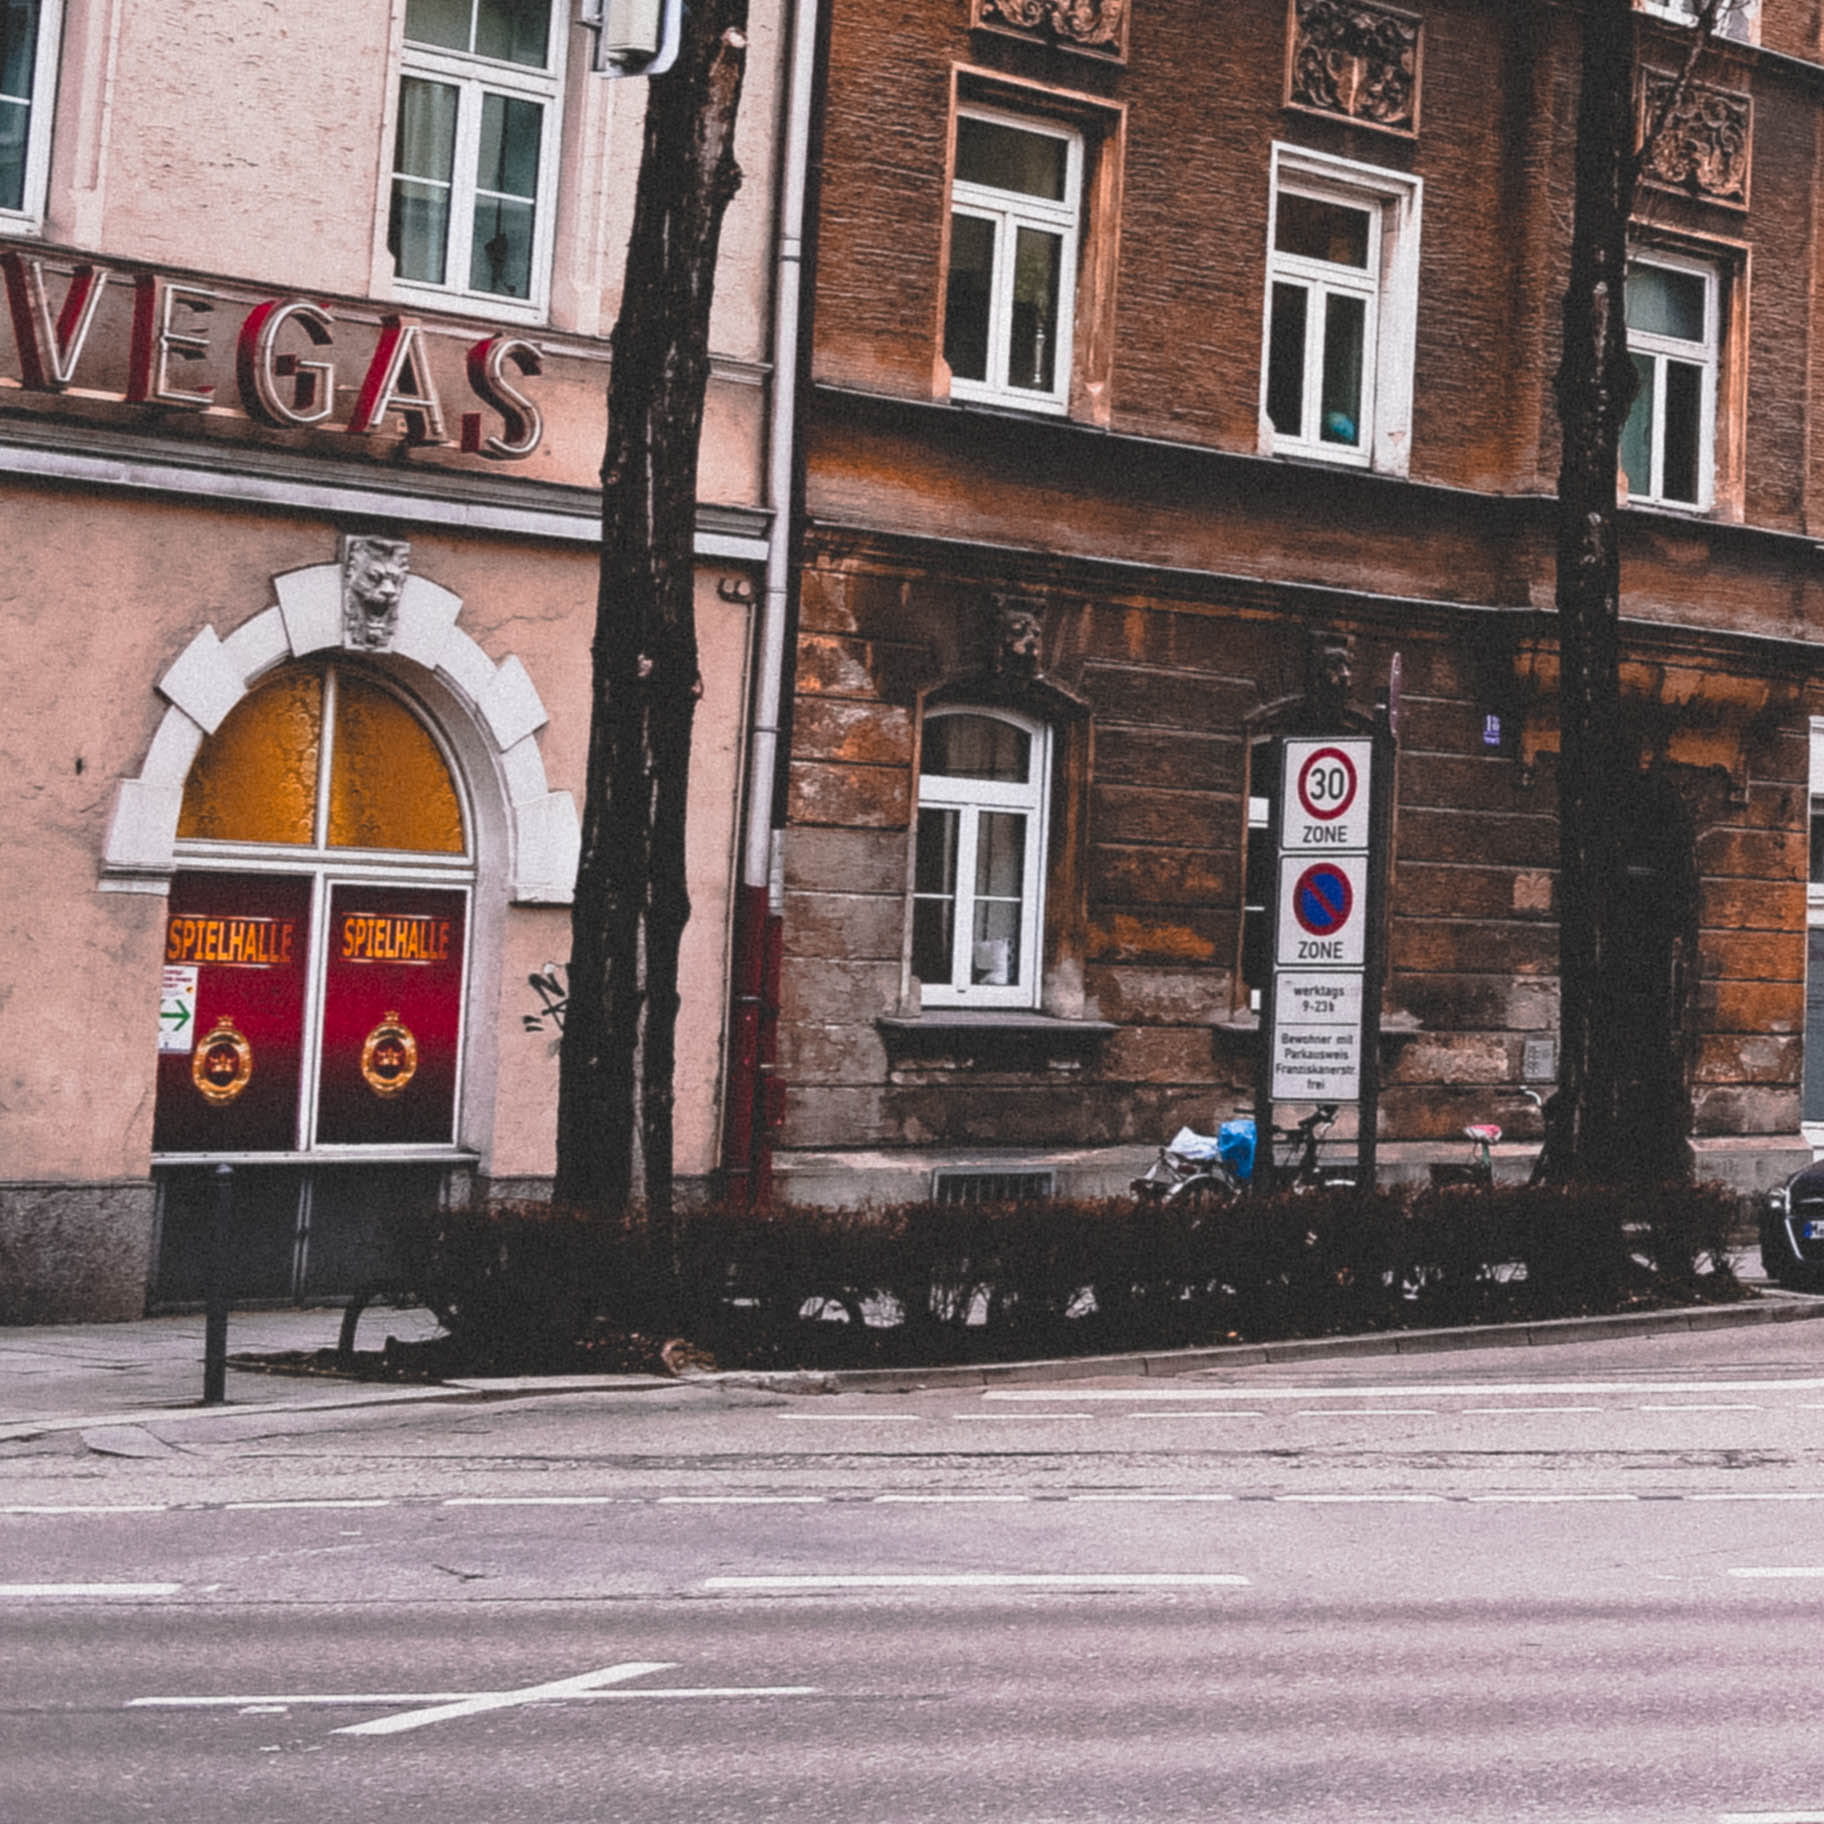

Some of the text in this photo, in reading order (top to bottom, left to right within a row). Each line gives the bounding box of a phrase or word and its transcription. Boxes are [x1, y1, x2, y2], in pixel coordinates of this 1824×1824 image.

[2, 252, 545, 459] VEGAS
[1309, 767, 1345, 801] 30
[1302, 825, 1348, 844] ZONE
[168, 918, 294, 964] SPIELHALLE
[341, 918, 450, 960] SPIELHALLE
[1298, 941, 1344, 960] ZONE
[1294, 985, 1345, 1000] werktags
[1284, 1048, 1349, 1060] Parkausweis
[1307, 1078, 1325, 1090] frei
